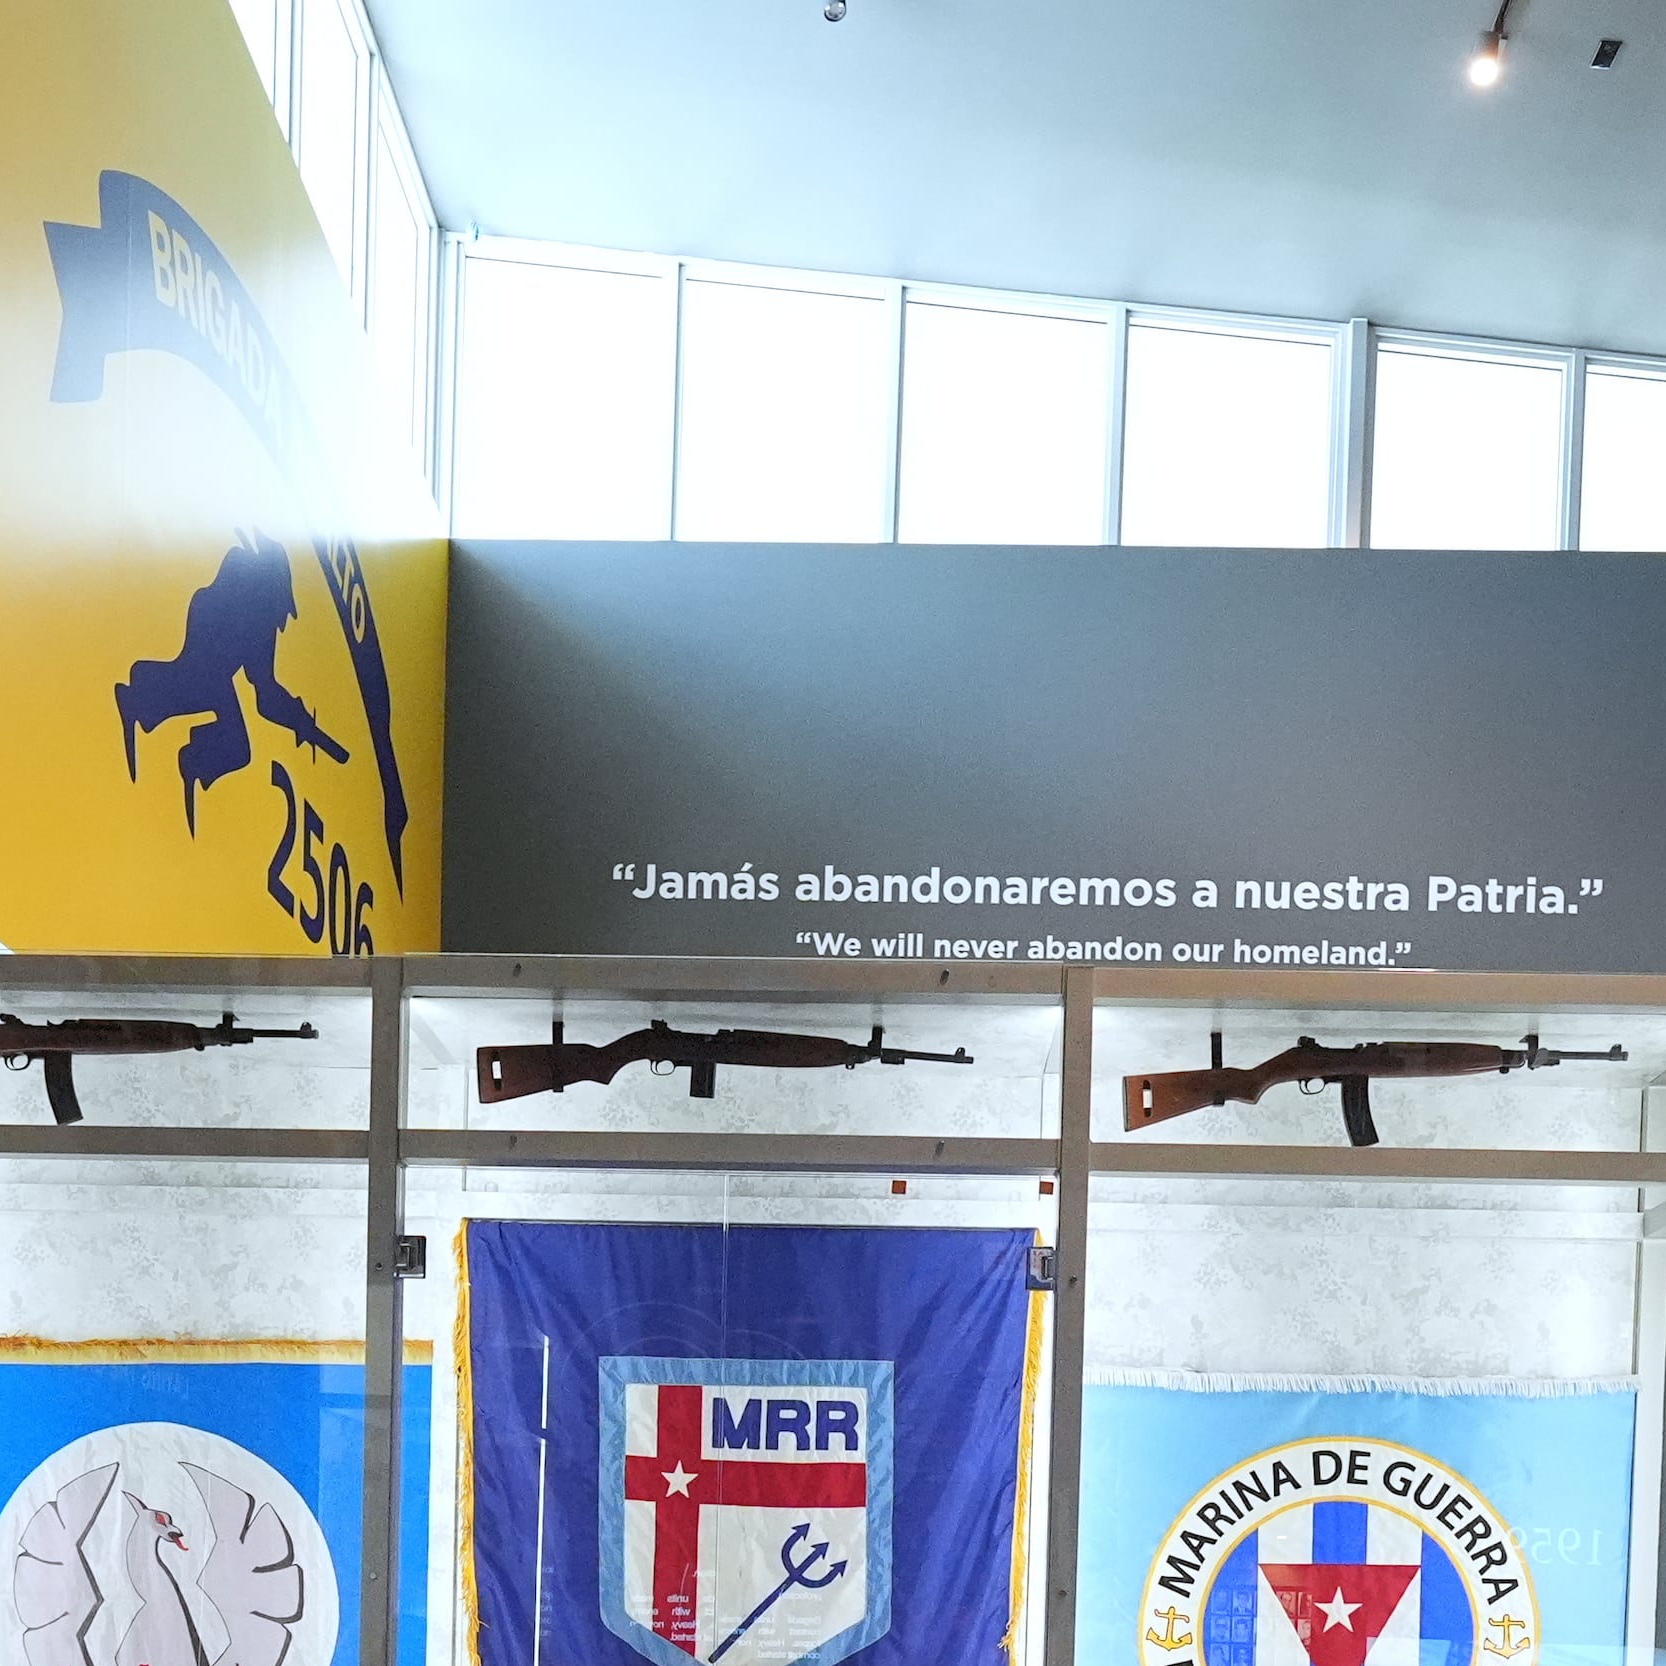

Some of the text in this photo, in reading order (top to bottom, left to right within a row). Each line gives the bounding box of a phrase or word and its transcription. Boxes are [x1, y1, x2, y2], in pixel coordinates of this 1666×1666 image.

[268, 760, 374, 955] 2506
[612, 862, 1604, 914] “Jamás abandonaremos a nuestra Patria.”
[795, 932, 1412, 966] “We will never abandon our homeland.”
[712, 1397, 859, 1451] MRR
[1158, 1449, 1519, 1605] MARINA DE GUERRA
